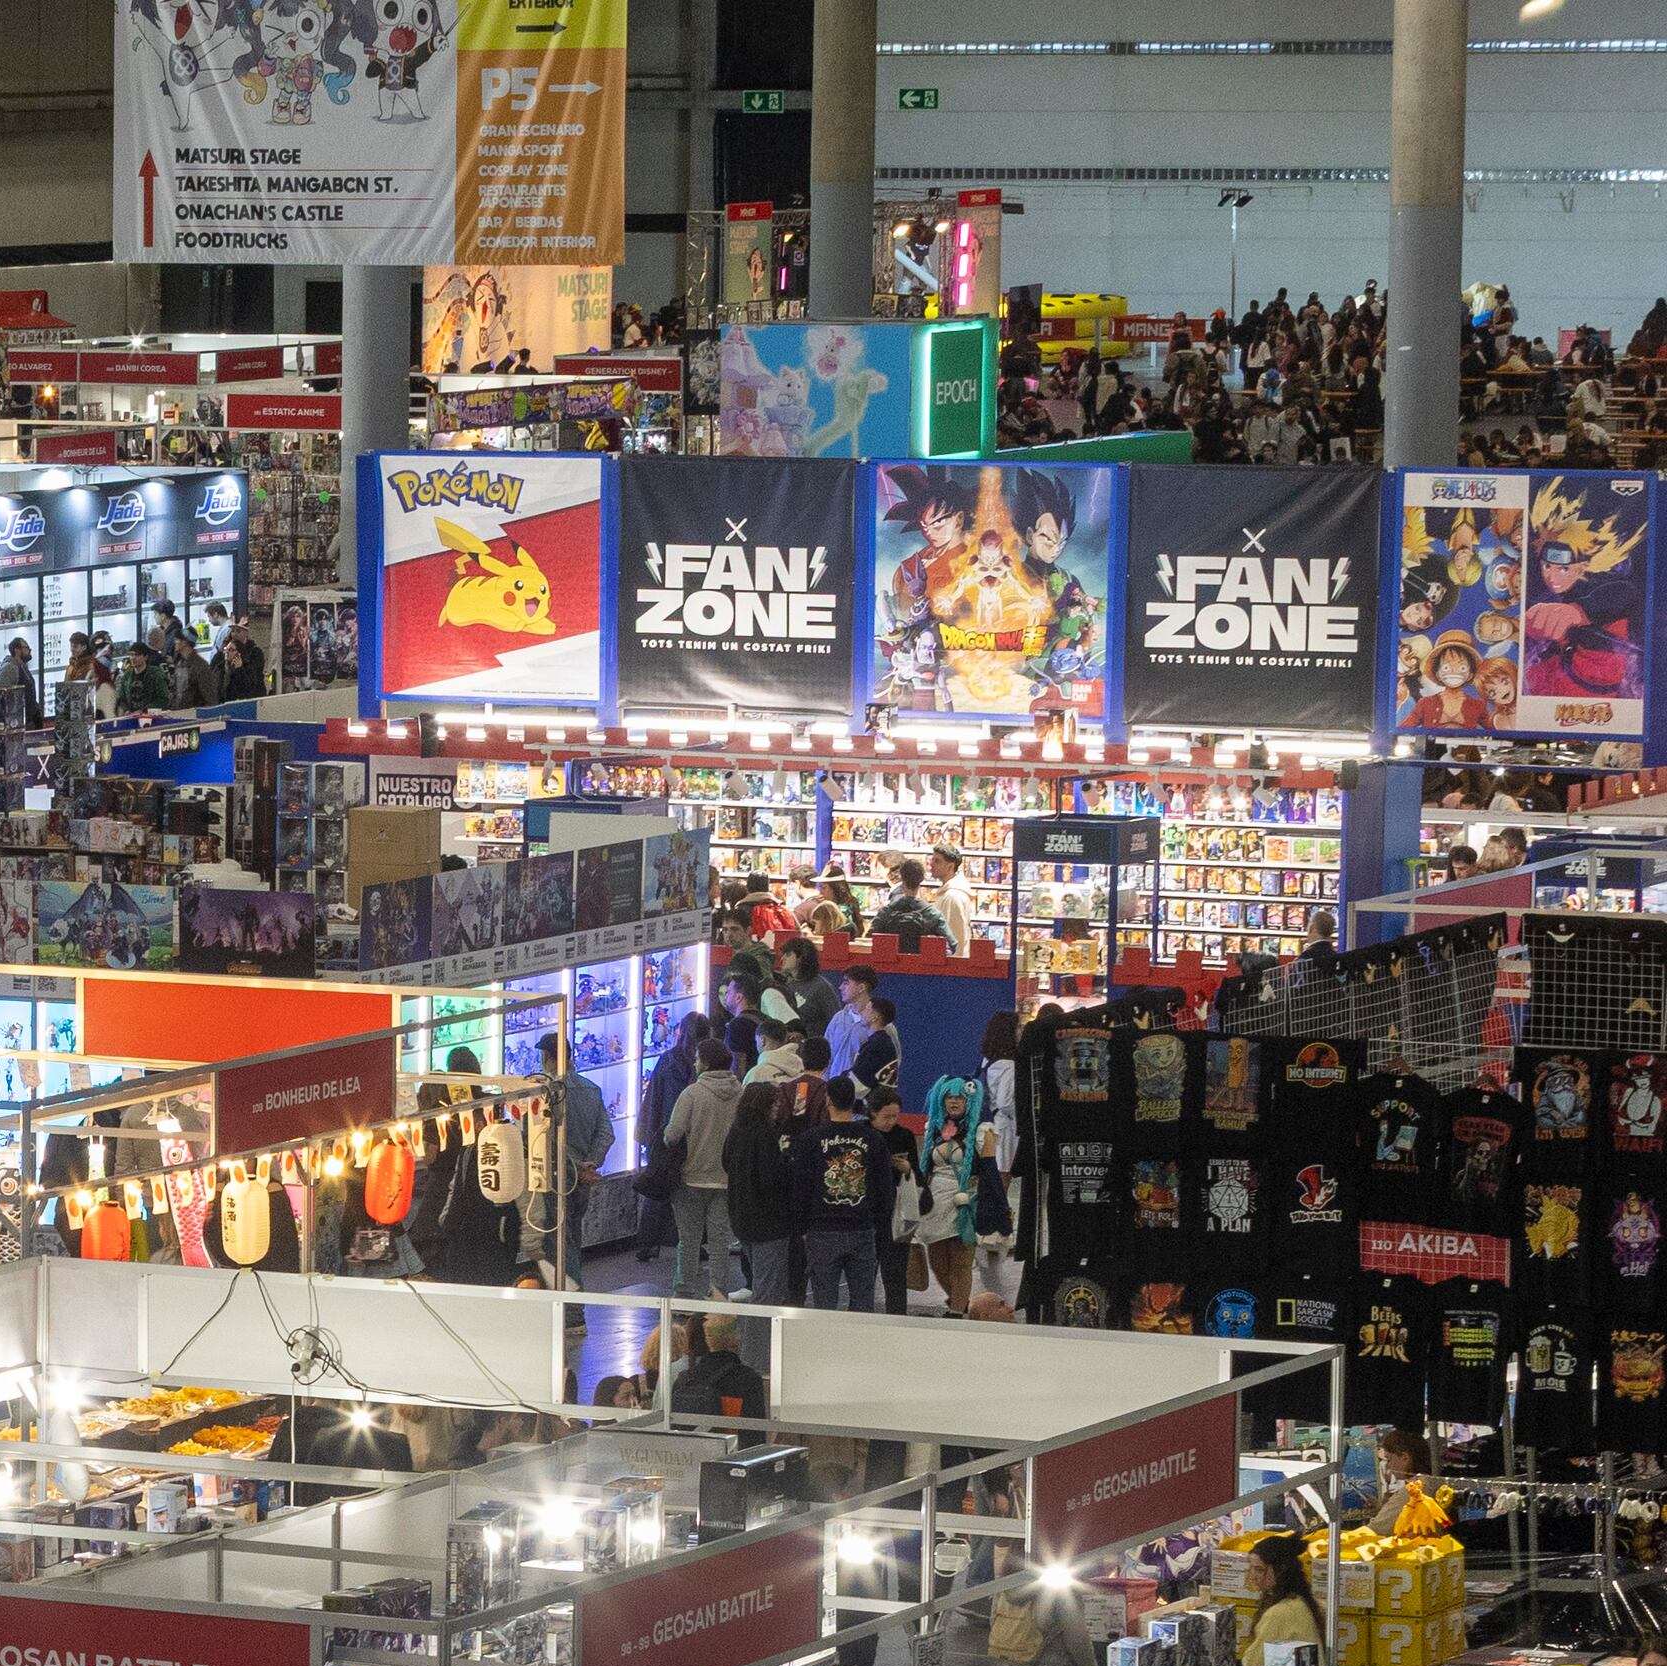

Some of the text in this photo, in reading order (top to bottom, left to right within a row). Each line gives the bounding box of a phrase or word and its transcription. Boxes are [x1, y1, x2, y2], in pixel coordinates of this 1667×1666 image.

[482, 67, 539, 112] P5
[479, 124, 585, 137] GRAN ESCENARIO
[175, 148, 301, 164] MATSURI STAGE
[478, 143, 564, 157] MANGASPORT
[478, 164, 569, 177] COSPLAY ZONE
[175, 176, 399, 193] TAKESHITA MANGABCN ST.
[478, 184, 566, 197] RESTAURANTES
[478, 196, 544, 209] JAPONESES
[175, 204, 343, 221] ONACHAN'S CASTLE
[478, 216, 503, 229] BAR
[516, 216, 564, 229] BEBIDAS
[175, 232, 288, 250] FOODTRUCKS
[478, 236, 596, 248] COMEDOR INTERIOR
[558, 272, 609, 297] MATSURI
[571, 298, 608, 322] STAGE
[140, 364, 166, 373] COREA
[585, 367, 667, 376] GENERATION DISNEY
[936, 378, 977, 405] EPOCH
[262, 408, 325, 417] ESTATIC ANIME
[98, 494, 144, 528] Jada
[195, 487, 241, 518] Jada
[665, 544, 812, 591] FAN
[1176, 556, 1330, 605] FAN
[636, 589, 836, 639] ZONE
[1144, 601, 1359, 653] ZONE
[939, 623, 996, 650] DRAGON
[641, 640, 831, 654] TOTS TENIM UN COSTAT FRIKI
[1149, 654, 1352, 669] TOTS TENIM UN COSTAT FRIKI
[161, 732, 190, 752] CAJAS
[378, 777, 452, 795] NUESTRO
[378, 791, 452, 810] CATÁLOGO
[1049, 834, 1079, 844] FAN
[1044, 843, 1083, 853] ZONE
[1289, 1067, 1345, 1080] NO INTERNET
[265, 1084, 321, 1111] BONHEUR
[323, 1081, 338, 1099] DE
[339, 1076, 361, 1097] LEA
[1370, 1100, 1421, 1123] SUPPORT
[1207, 1165, 1251, 1181] I HAVE
[1207, 1218, 1251, 1233] A PLAN
[1371, 1232, 1478, 1257] 110 AKIBA
[1216, 1288, 1257, 1305] EMOTIONAL
[1296, 1298, 1338, 1313] NATIONAL
[1296, 1307, 1334, 1319] SARCASM
[1296, 1315, 1329, 1326] SOCIETY
[621, 1642, 633, 1657] 96
[639, 1636, 650, 1650] 99
[653, 1609, 717, 1646] GEOSAN
[719, 1585, 774, 1625] BATTLE
